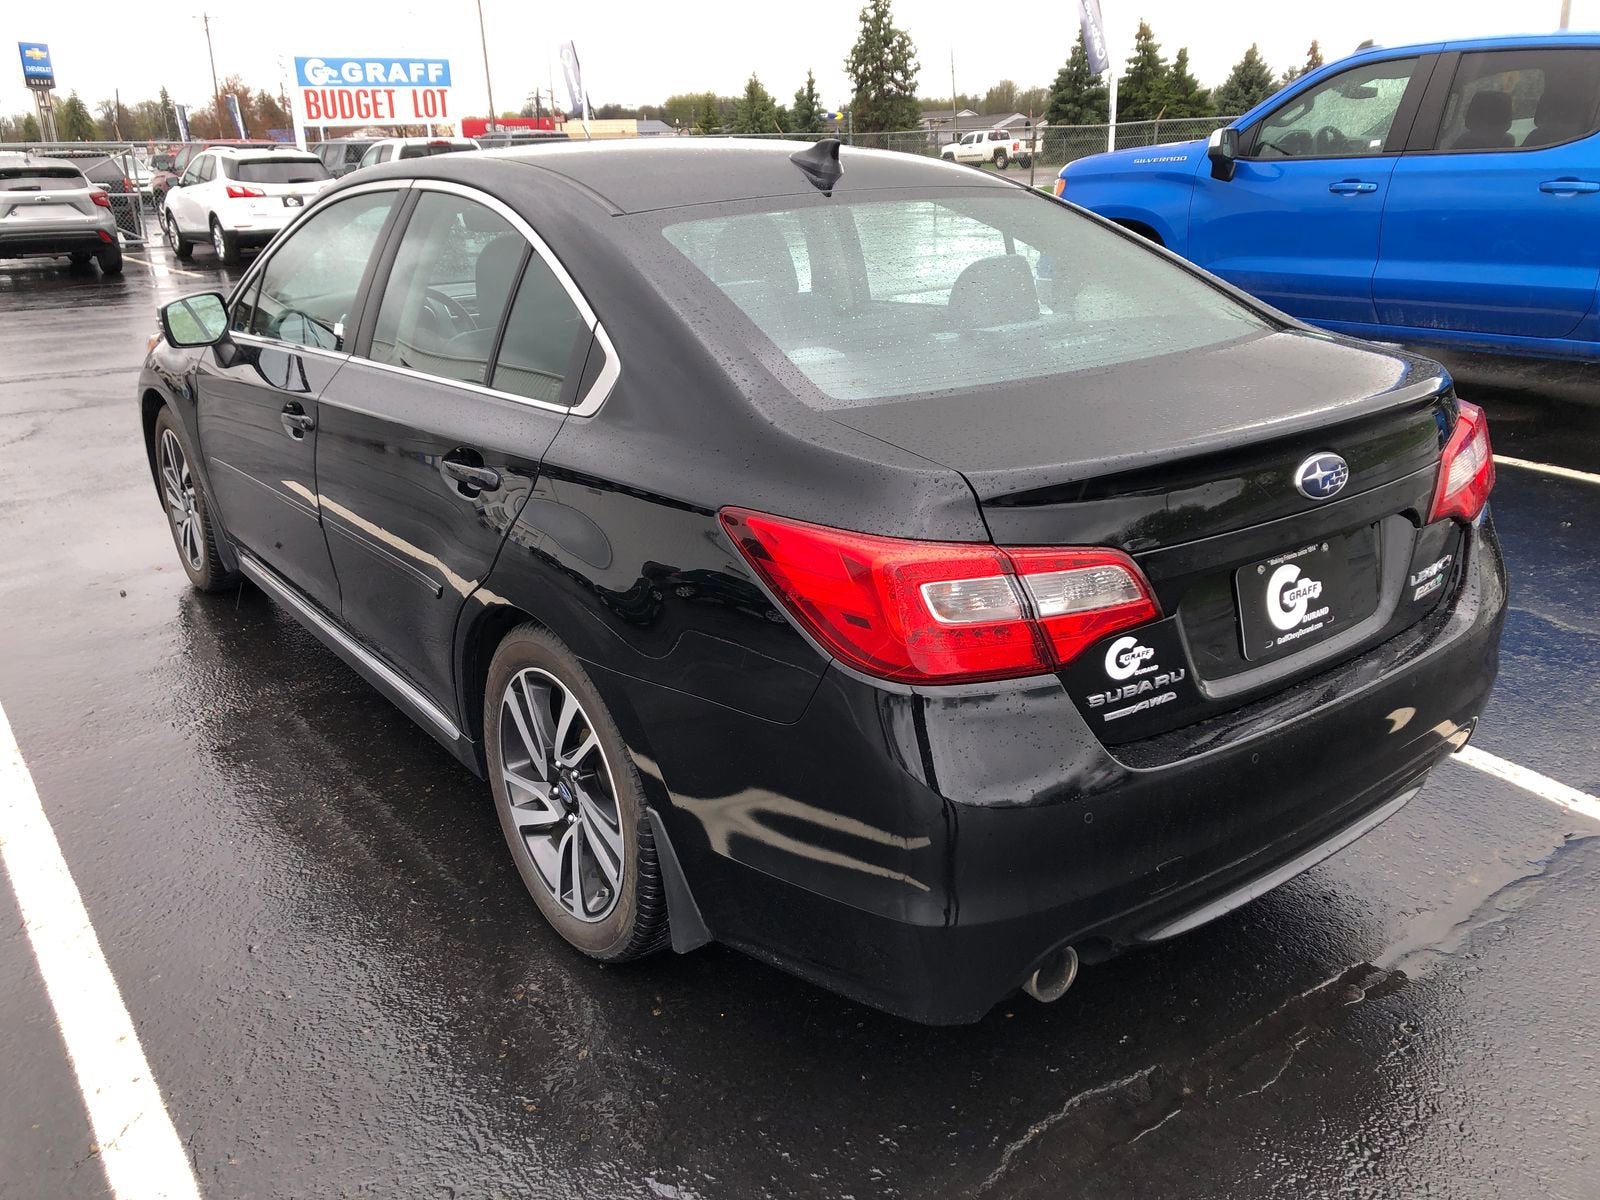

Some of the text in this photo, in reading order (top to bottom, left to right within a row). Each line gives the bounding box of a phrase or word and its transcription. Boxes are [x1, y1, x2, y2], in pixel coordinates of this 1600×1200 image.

[341, 61, 444, 83] GRAFF
[303, 89, 448, 119] BUDGET LOT
[1133, 155, 1188, 164] SILVERADO
[1289, 583, 1318, 601] GRAFF
[1302, 606, 1329, 623] DURAND
[1124, 649, 1151, 662] GRAFF
[1086, 668, 1185, 708] SUBARU
[1132, 691, 1178, 713] AWD
